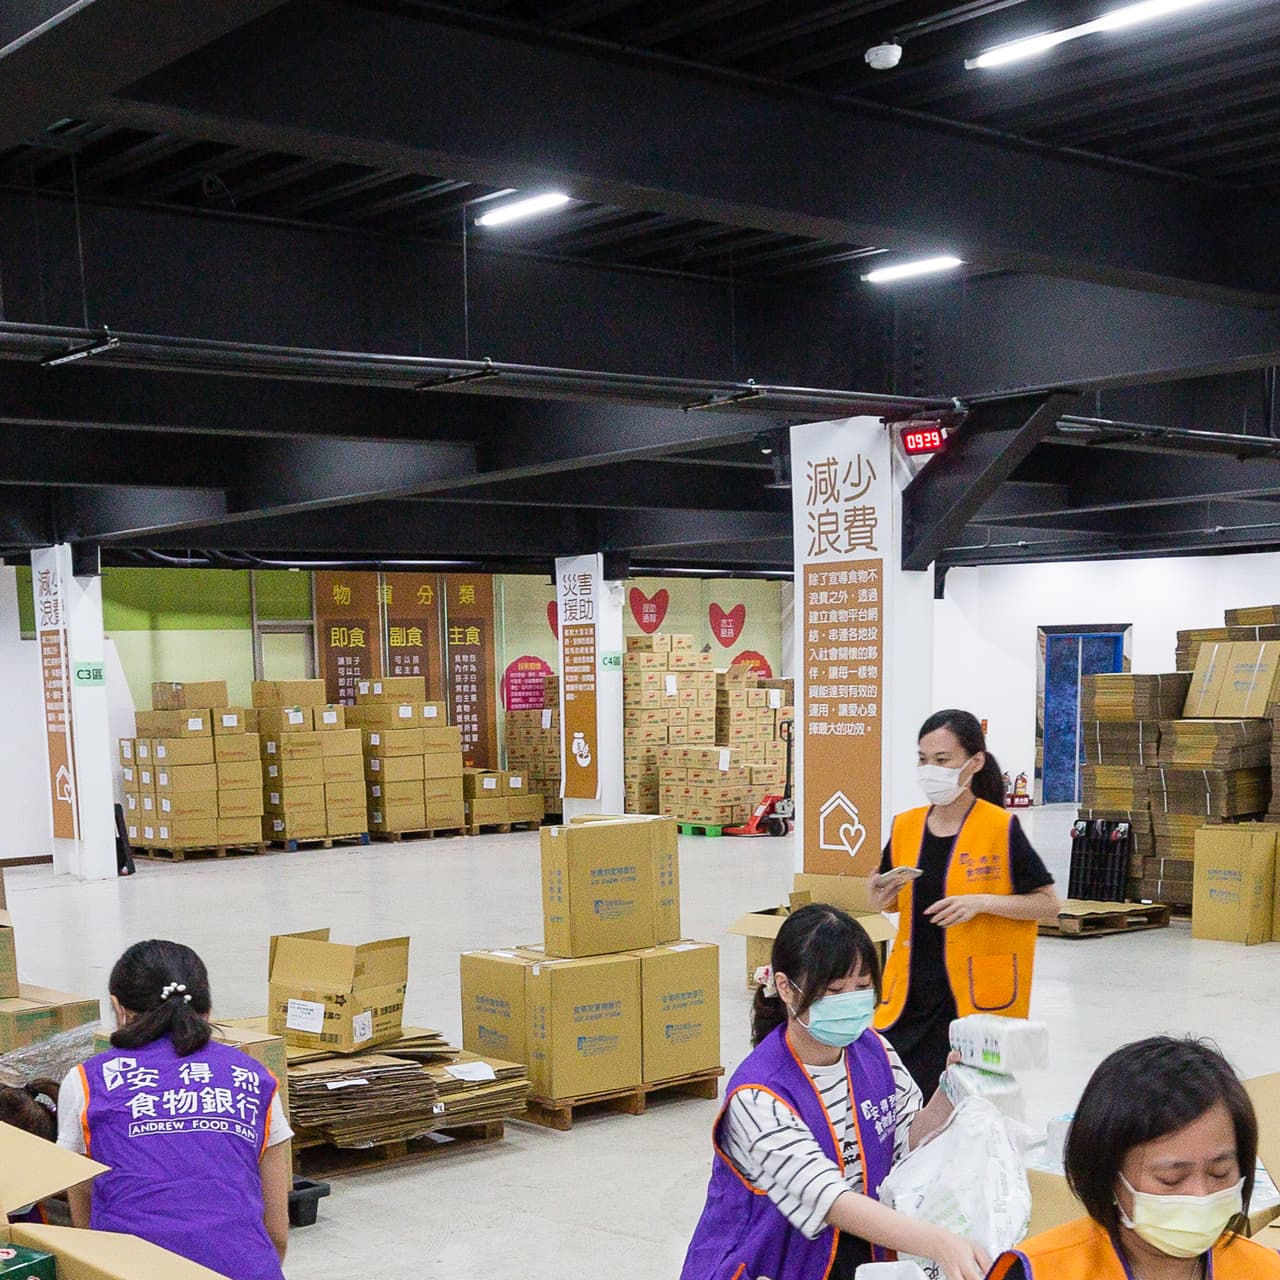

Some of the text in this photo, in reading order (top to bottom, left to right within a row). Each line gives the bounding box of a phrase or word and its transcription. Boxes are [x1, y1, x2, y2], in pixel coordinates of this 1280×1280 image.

[806, 453, 876, 506] 減少
[807, 505, 878, 557] 浪費
[563, 573, 593, 597] 災害
[563, 598, 593, 621] 援助
[330, 627, 366, 648] 即食
[390, 626, 423, 647] 副食
[449, 626, 480, 646] 主食
[76, 668, 103, 680] C3區
[126, 1062, 261, 1094] 安得烈
[125, 1086, 260, 1126] 食物銀行
[131, 1120, 256, 1140] ANDREW FOOD BAN
